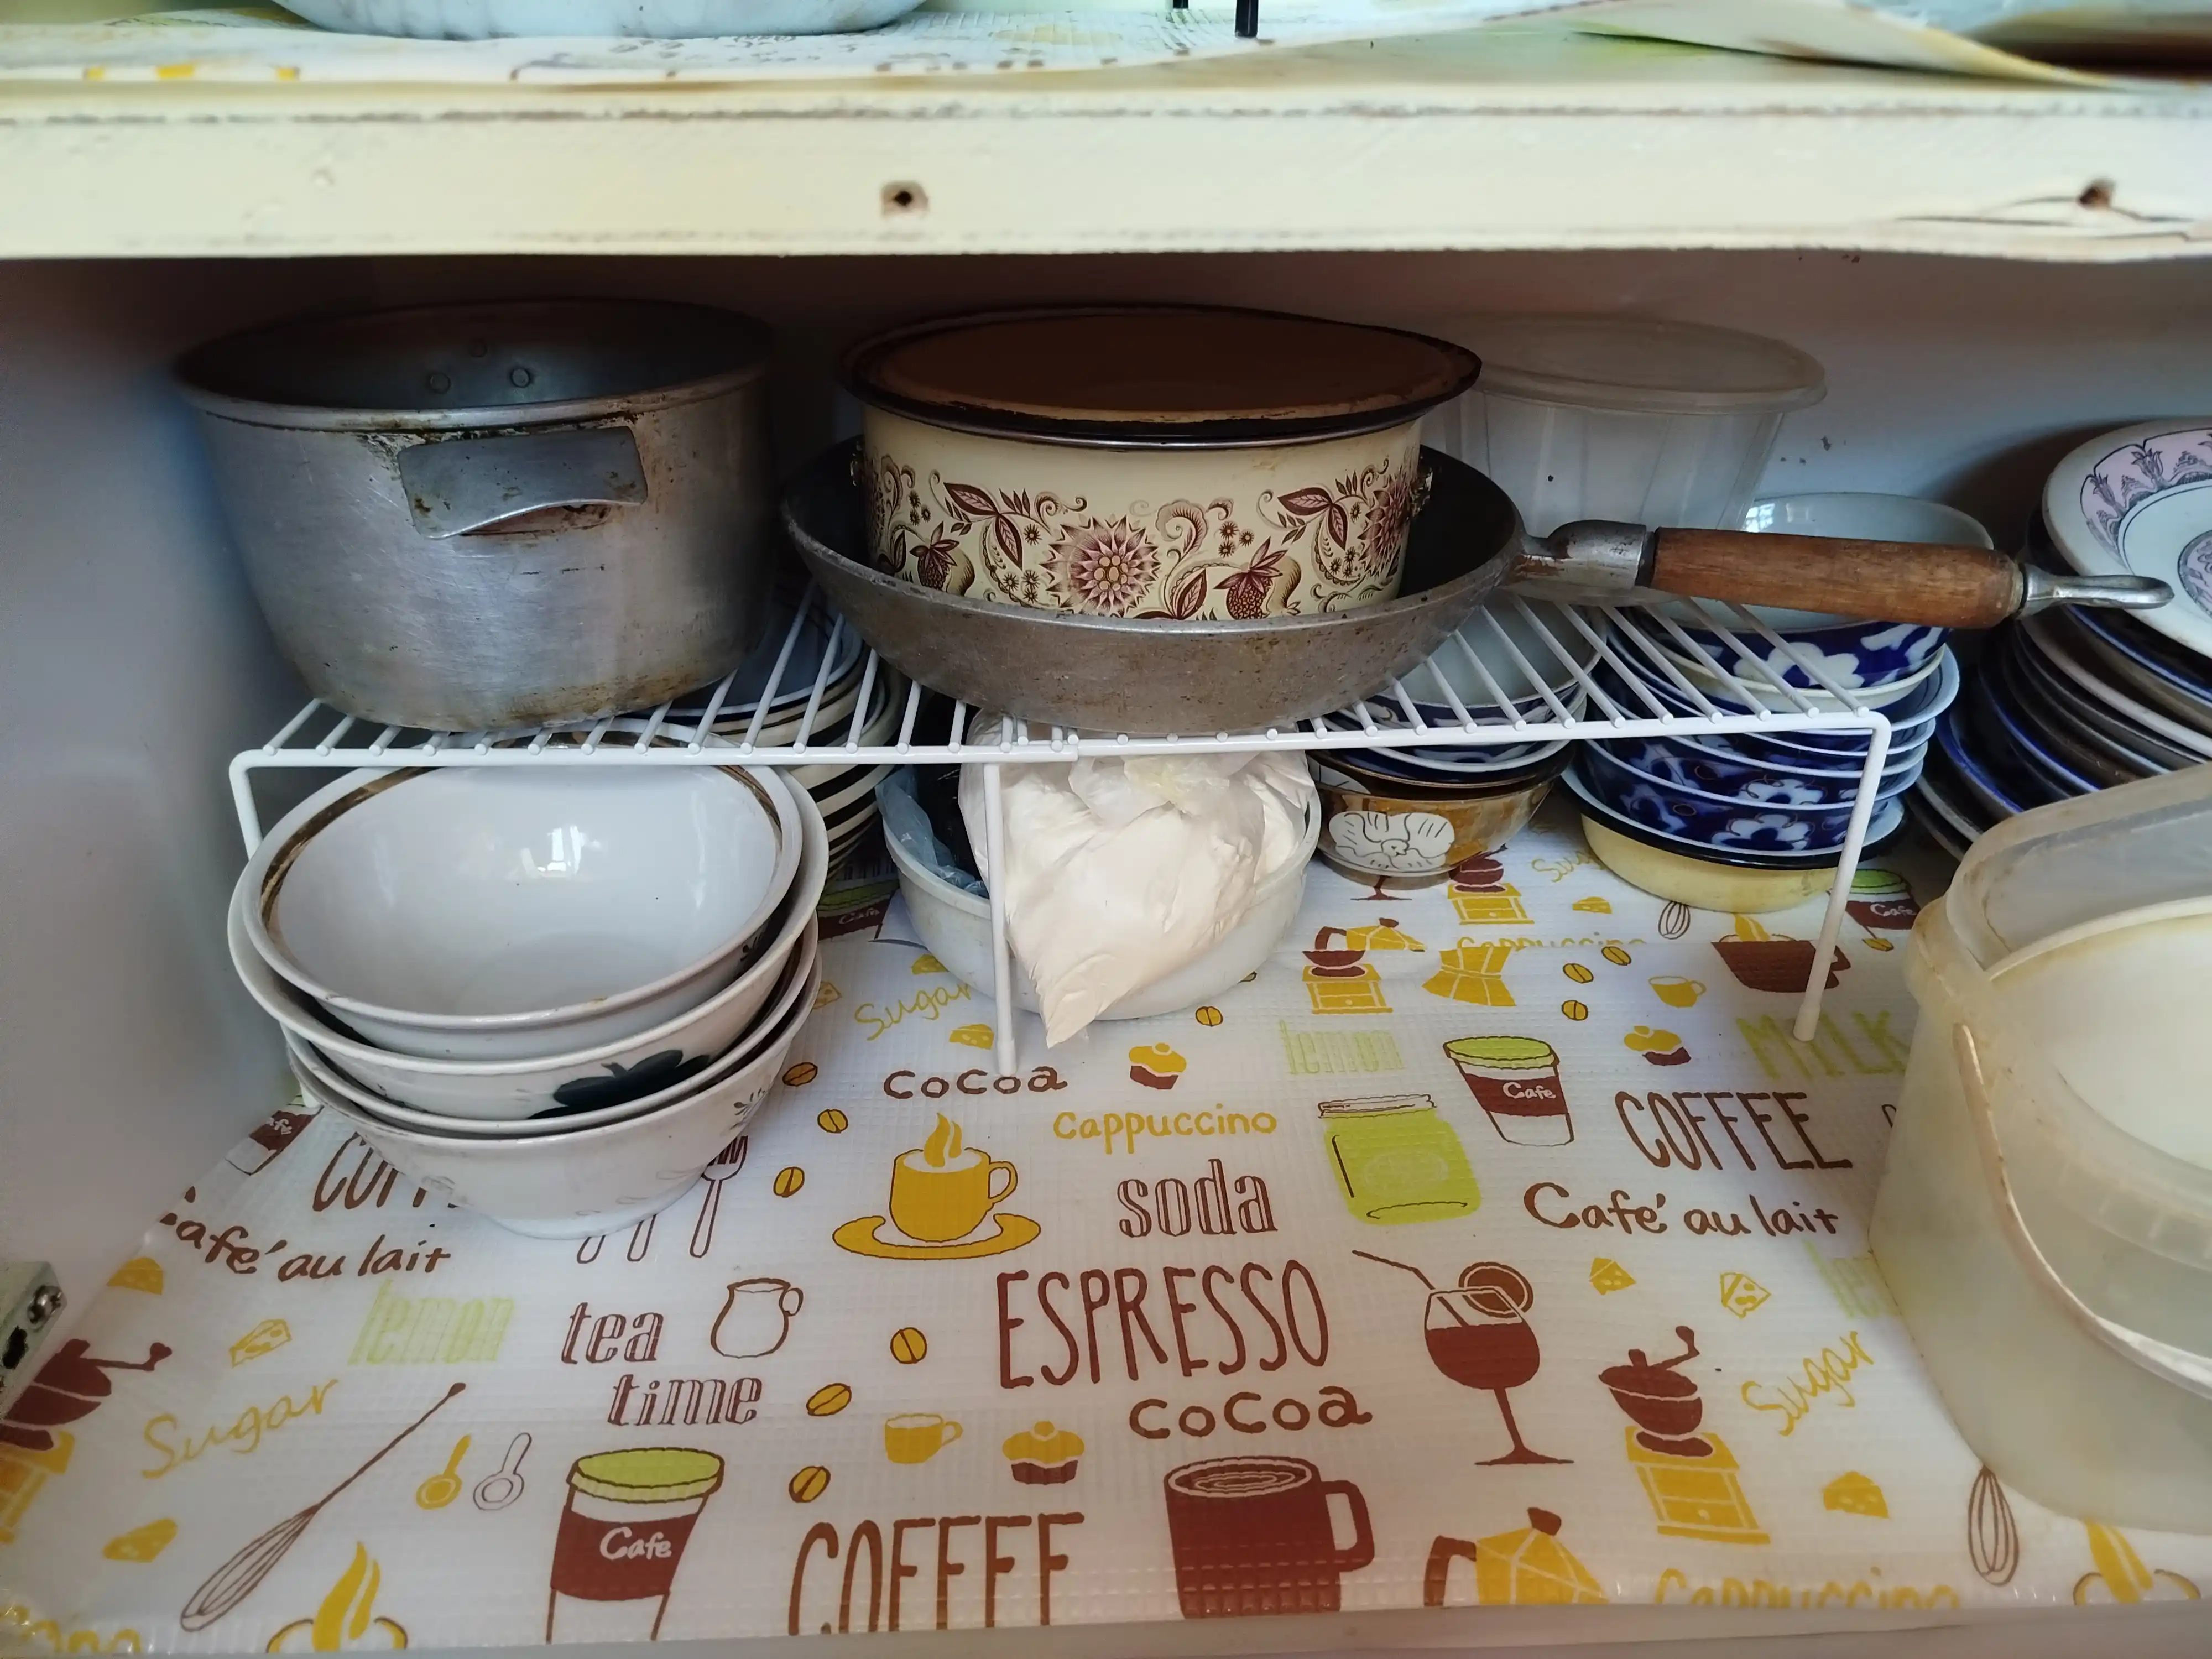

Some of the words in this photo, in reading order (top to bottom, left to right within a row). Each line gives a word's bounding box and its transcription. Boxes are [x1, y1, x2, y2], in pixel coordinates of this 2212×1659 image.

[1870, 903, 1916, 917] Cafe
[854, 983, 972, 1041] Sugar
[1279, 1020, 1405, 1074] lemon
[1503, 1082, 1556, 1099] Cafe
[1615, 1091, 1853, 1171] COFFEE
[1117, 1159, 1278, 1238] soda
[1684, 1209, 1752, 1235] au
[1749, 1194, 1838, 1237] lait
[278, 1254, 346, 1282] au
[358, 1234, 451, 1276] lait
[347, 1278, 514, 1365] lemon
[561, 1302, 664, 1364] tea
[997, 1260, 1329, 1389] ESPRESSO
[608, 1374, 762, 1426] time
[1741, 1331, 1875, 1436] Sugar
[142, 1379, 338, 1478] Sugar
[599, 1527, 671, 1560] Cafe
